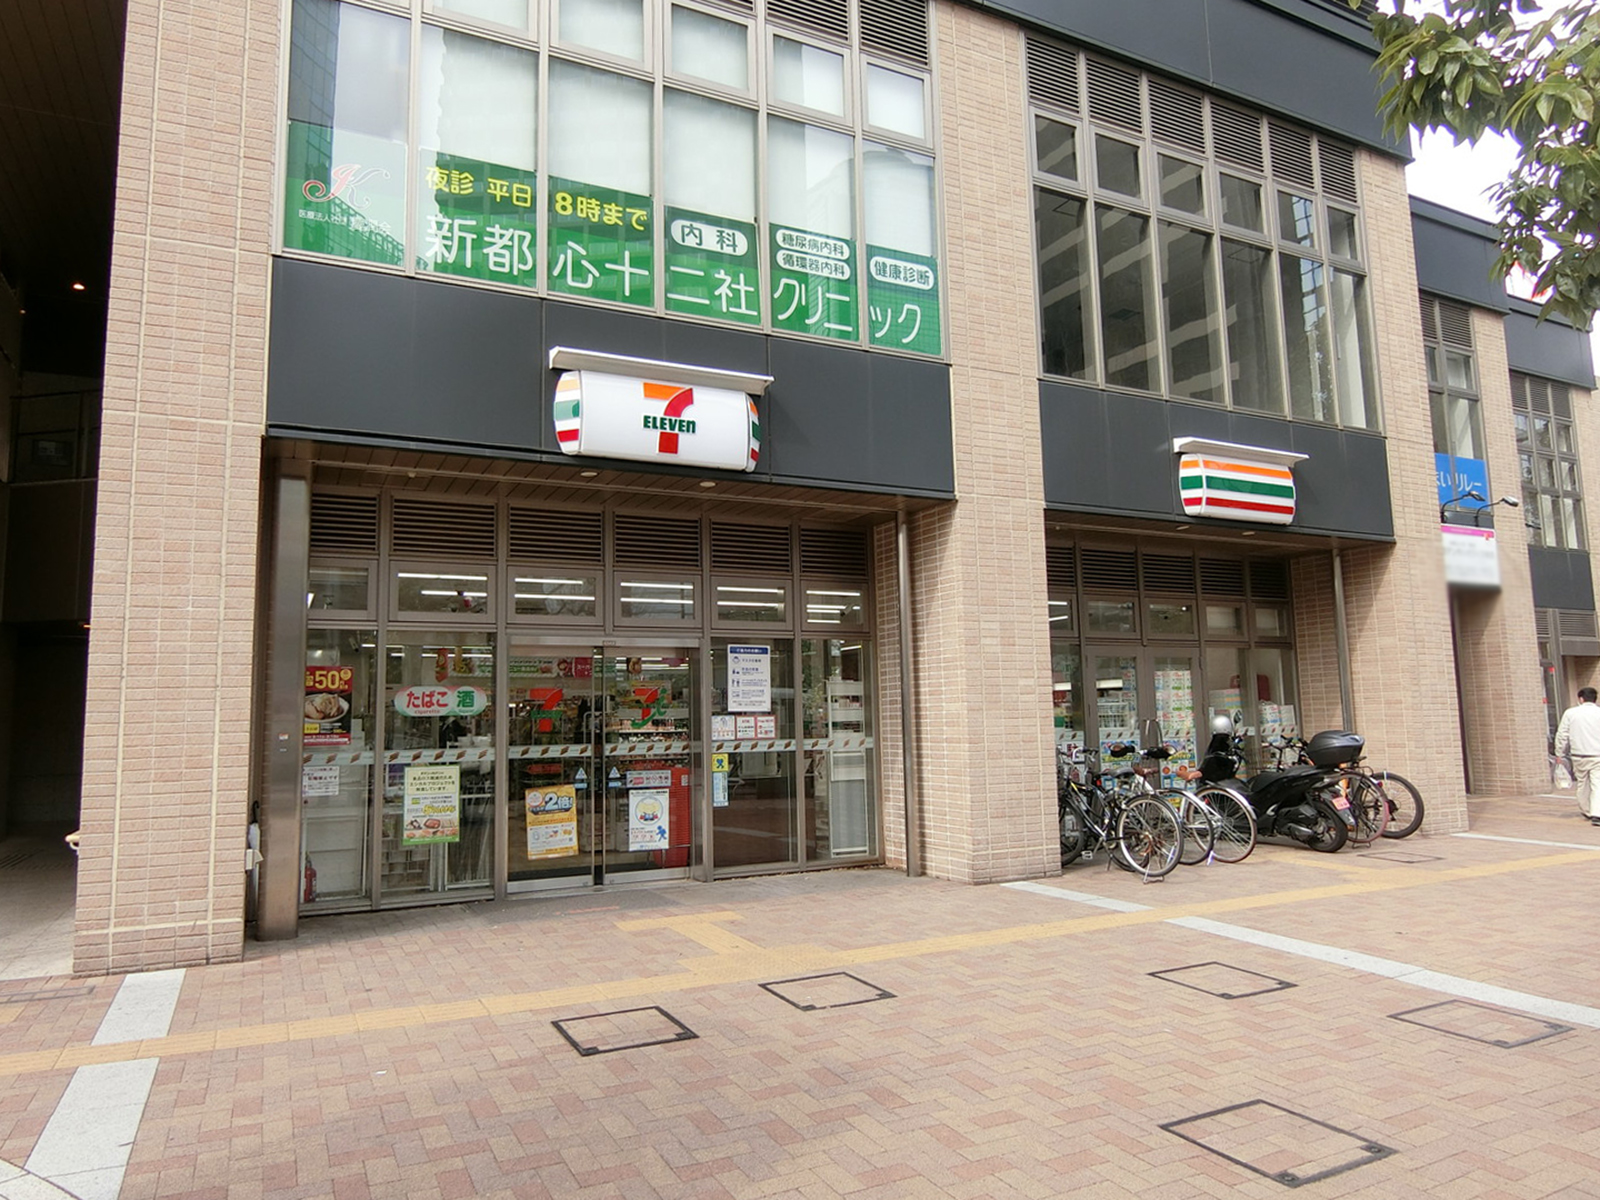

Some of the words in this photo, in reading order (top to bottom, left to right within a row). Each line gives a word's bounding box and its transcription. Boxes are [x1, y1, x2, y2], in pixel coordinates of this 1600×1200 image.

[425, 166, 474, 195] 夜診
[486, 177, 533, 208] 平日
[554, 192, 648, 231] 8時まで
[680, 224, 738, 253] 内科
[781, 232, 846, 258] 糖尿病内科
[781, 252, 846, 277] 循環器内科
[874, 260, 931, 286] 健康診断
[406, 689, 449, 709] たばこ
[456, 690, 475, 708] 酒
